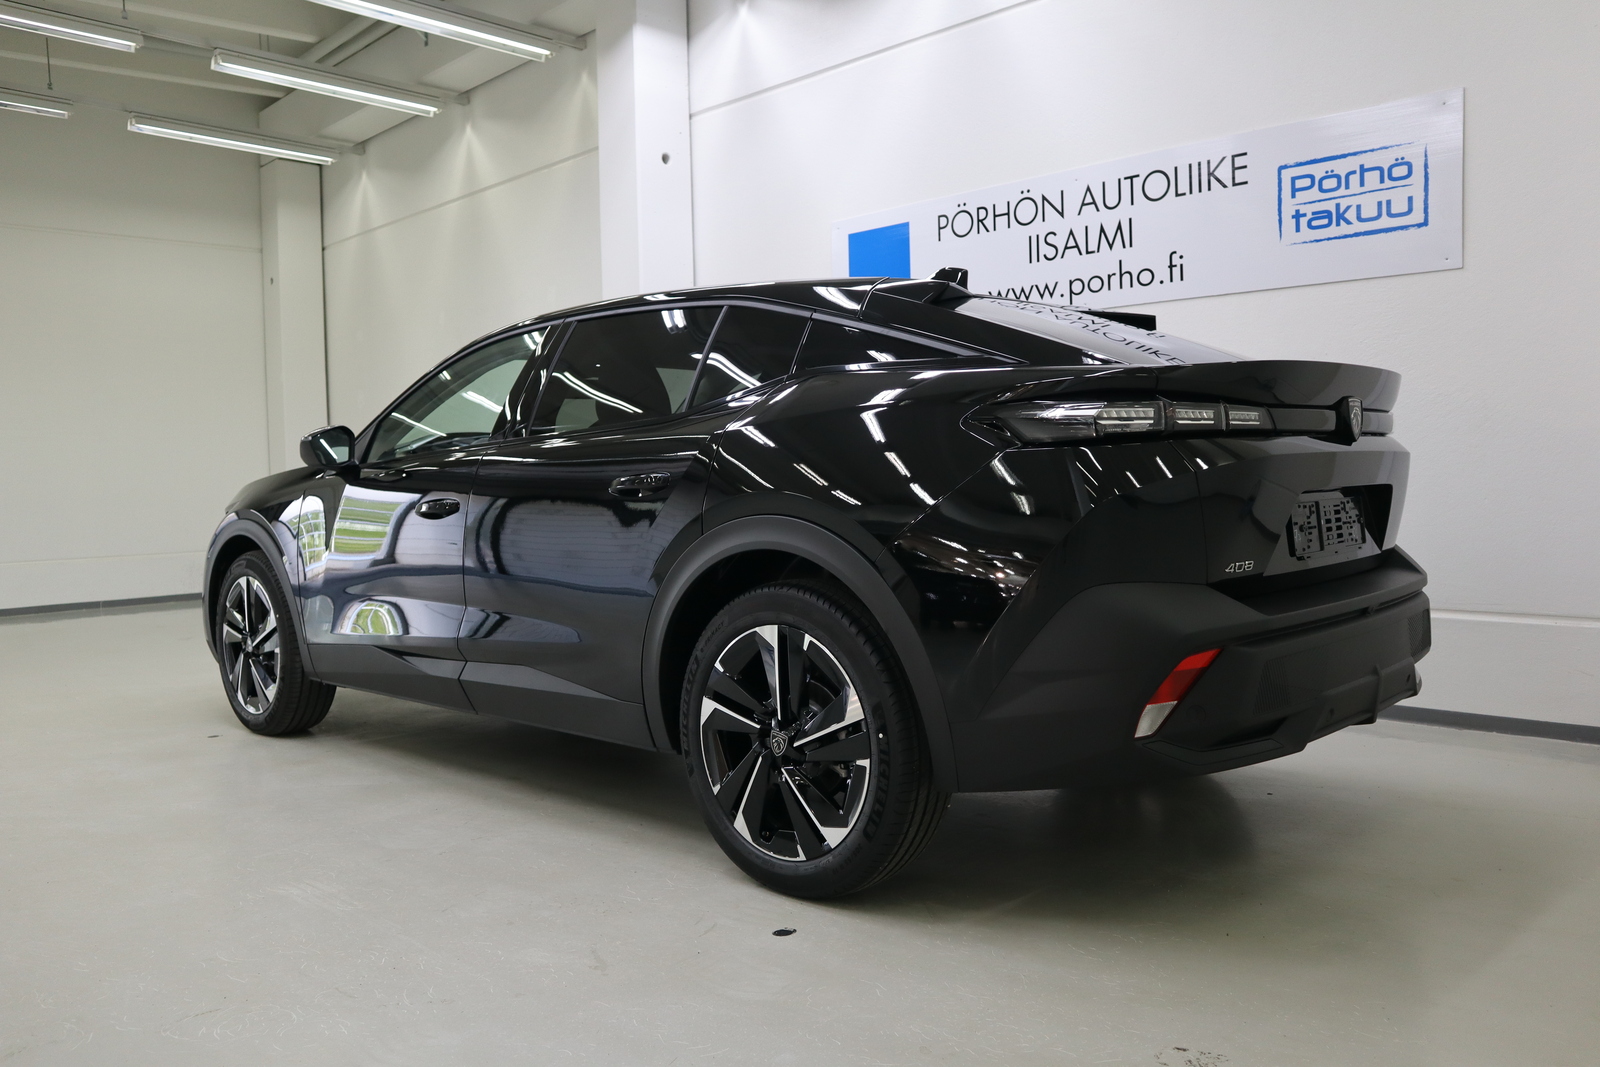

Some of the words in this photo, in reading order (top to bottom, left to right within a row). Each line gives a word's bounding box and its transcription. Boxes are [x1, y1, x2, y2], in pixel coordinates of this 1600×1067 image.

[937, 189, 1065, 242] PÖRHÖN
[1077, 152, 1249, 216] AUTOLIIKE
[1290, 156, 1413, 199] Pörhö
[1291, 195, 1414, 233] takuu
[1028, 217, 1133, 264] IISALMI
[1224, 560, 1254, 573] 408
